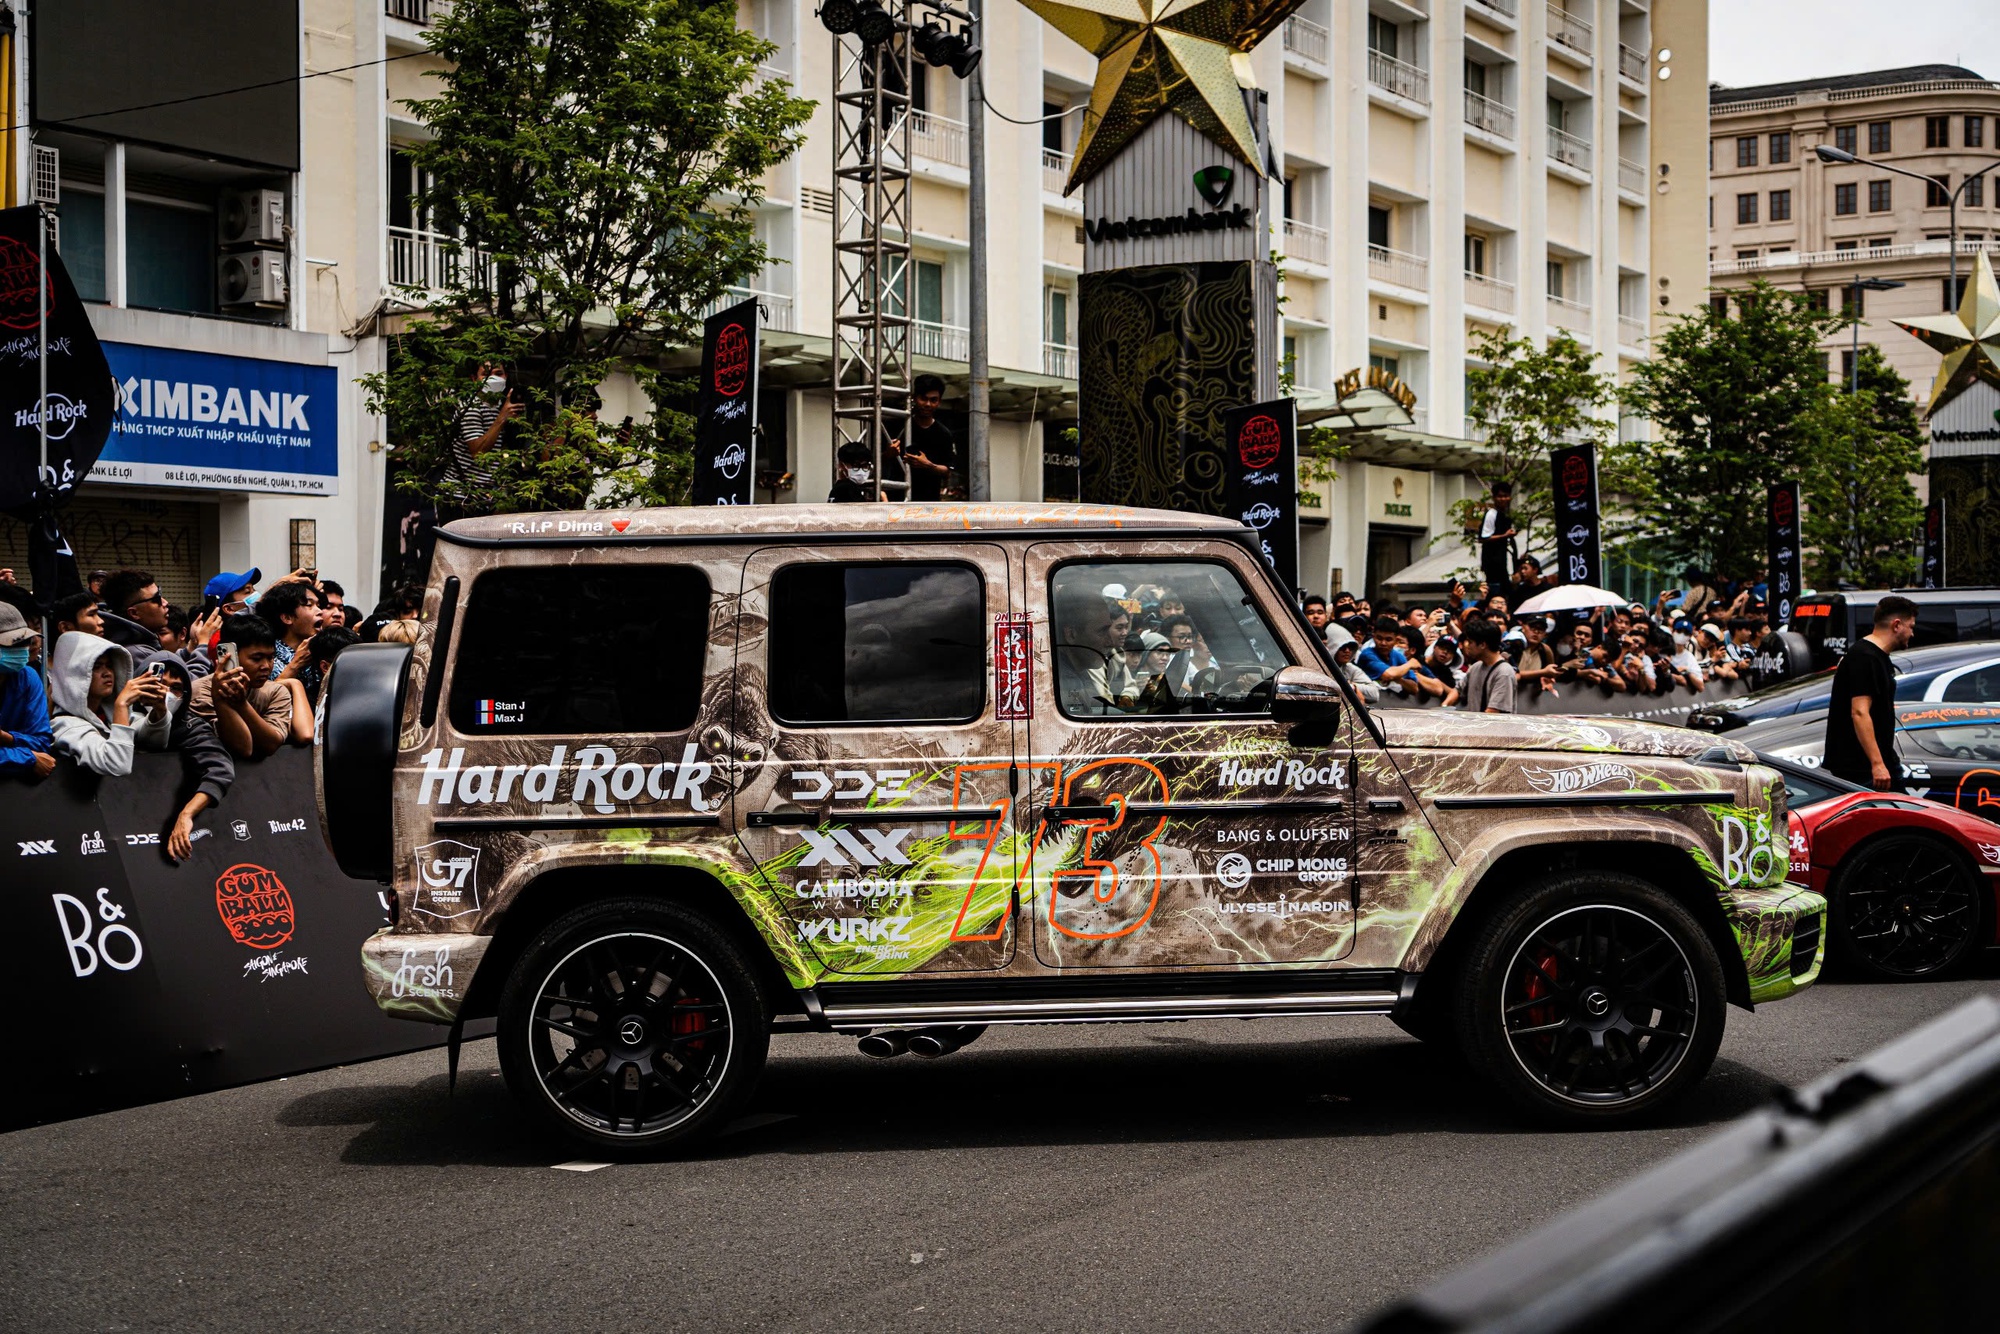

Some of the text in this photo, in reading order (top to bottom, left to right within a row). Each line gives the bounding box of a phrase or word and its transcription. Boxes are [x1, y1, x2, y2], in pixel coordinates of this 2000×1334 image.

[717, 330, 747, 353] GUM
[55, 399, 87, 422] Rock
[112, 420, 144, 435] HÀNG
[146, 424, 175, 437] TMCP
[177, 425, 204, 439] XUẤT
[206, 429, 235, 443] NHẬP
[266, 433, 288, 448] VIỆT
[290, 437, 311, 448] NAM
[1242, 420, 1277, 437] GUM
[714, 452, 733, 468] Hard
[88, 466, 132, 479] ANK LÊ LỢI
[165, 472, 174, 480] 08
[175, 471, 184, 481] LÊ
[298, 480, 324, 490] TP.HCM
[1242, 507, 1280, 521] Hard Rock
[558, 520, 603, 532] Dima
[995, 610, 1034, 621] ON THE
[495, 701, 525, 710] Stan J
[495, 713, 523, 722] Max J
[417, 743, 711, 814] Hard Rock
[1218, 759, 1345, 791] Hard Rock
[81, 830, 105, 855] frsh
[1217, 828, 1349, 843] BANG & OLUFSEN
[950, 758, 1170, 942] 73
[1256, 858, 1347, 872] CHIP MONG
[218, 871, 281, 899] GUM
[1298, 871, 1347, 882] GROUP
[795, 878, 913, 898] CAMBODIA
[221, 890, 288, 918] BALL
[812, 900, 899, 909] WATER
[1219, 901, 1349, 913] ULYSSE NARDIN
[231, 914, 294, 941] 3000
[797, 916, 913, 943] WURKZ
[875, 951, 909, 960] DRINK
[260, 956, 308, 983] SINGAPORE
[391, 944, 453, 998] frsh
[408, 988, 454, 998] SCENTS
